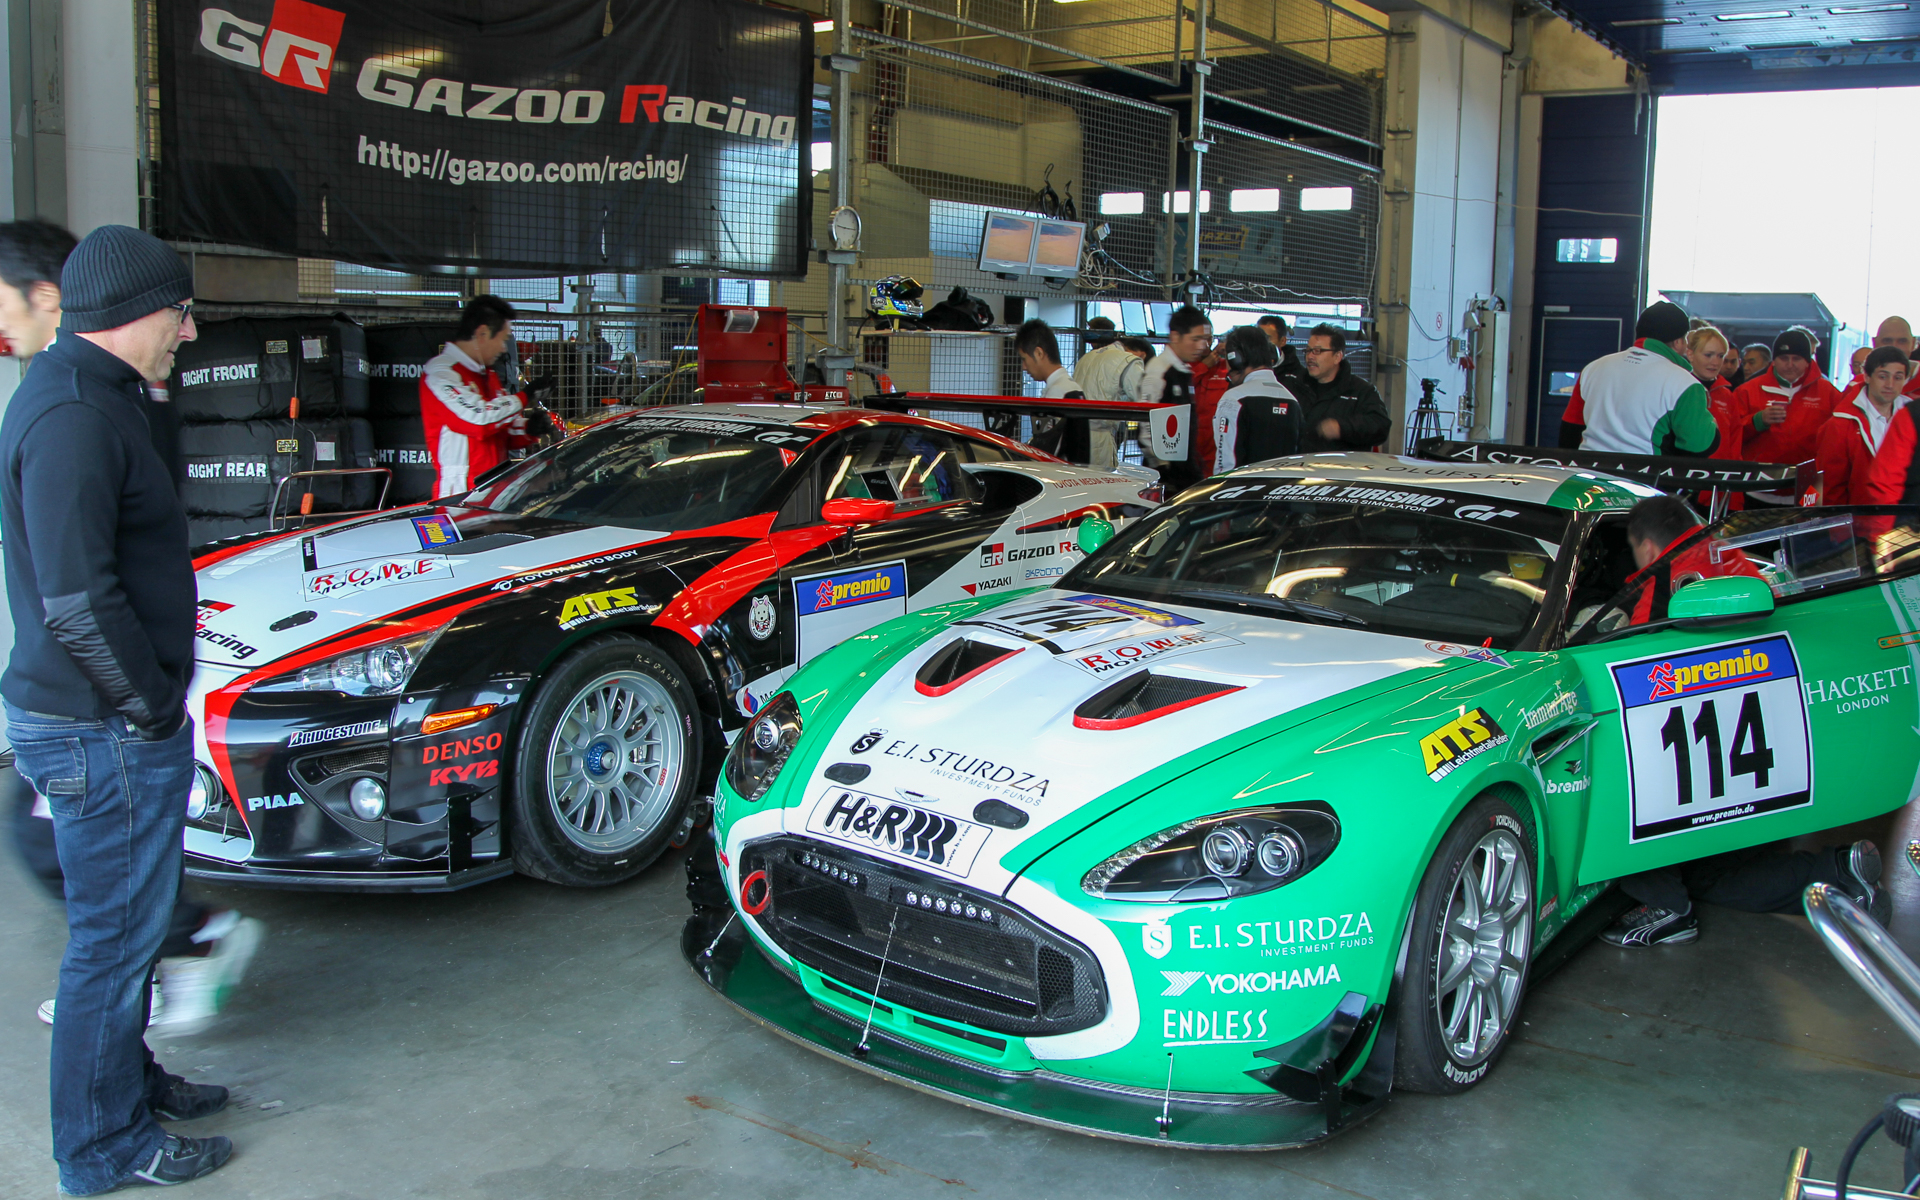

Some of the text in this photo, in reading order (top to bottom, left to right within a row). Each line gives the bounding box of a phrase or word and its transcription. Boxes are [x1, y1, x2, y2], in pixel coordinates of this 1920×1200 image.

[357, 58, 797, 151] GAZOO Racing
[358, 135, 689, 185] http://gazoo.com/racing/
[182, 363, 258, 387] RIGHT FRONT
[392, 364, 425, 378] FRON
[1273, 407, 1287, 415] GR
[188, 462, 267, 478] RIGHT REAR
[1268, 484, 1446, 508] GRAN TURISMO
[1312, 497, 1359, 505] DRIVING
[1360, 500, 1428, 513] SIMULATOR
[1803, 493, 1817, 507] DOW
[515, 549, 638, 583] TOYOTA AUTO BODY
[981, 552, 1003, 567] GR
[1008, 545, 1055, 562] GAZOO
[832, 575, 892, 606] premio
[978, 576, 1012, 590] YAZAKI
[559, 586, 638, 625] ATS
[997, 604, 1134, 634] 114
[1081, 632, 1205, 668] ROWE
[1675, 648, 1770, 693] premio
[1804, 665, 1911, 705] HACKETT
[1836, 694, 1889, 714] LONDON
[288, 720, 381, 748] BRIDGESTONE
[422, 732, 503, 764] DENSO
[1419, 709, 1491, 775] ATS
[1660, 691, 1774, 806] 114
[1451, 734, 1510, 770] Leichtmetallräder
[429, 759, 499, 786] KYB
[883, 739, 1051, 799] E.I. STURDZA
[248, 792, 305, 811] PIAA
[929, 767, 1043, 808] INVESTMENT FUNDS
[824, 792, 904, 847] H&R
[1495, 815, 1522, 837] YOKOHAMA
[1691, 804, 1755, 825] www.premio.de
[1189, 911, 1374, 950] E.I. STURDZA
[1260, 936, 1374, 957] INVESTMENT FUNDS
[1205, 963, 1341, 994] YOKOHAMA
[1163, 1009, 1269, 1039] ENDLESS
[1443, 1059, 1488, 1084] ADVAN
